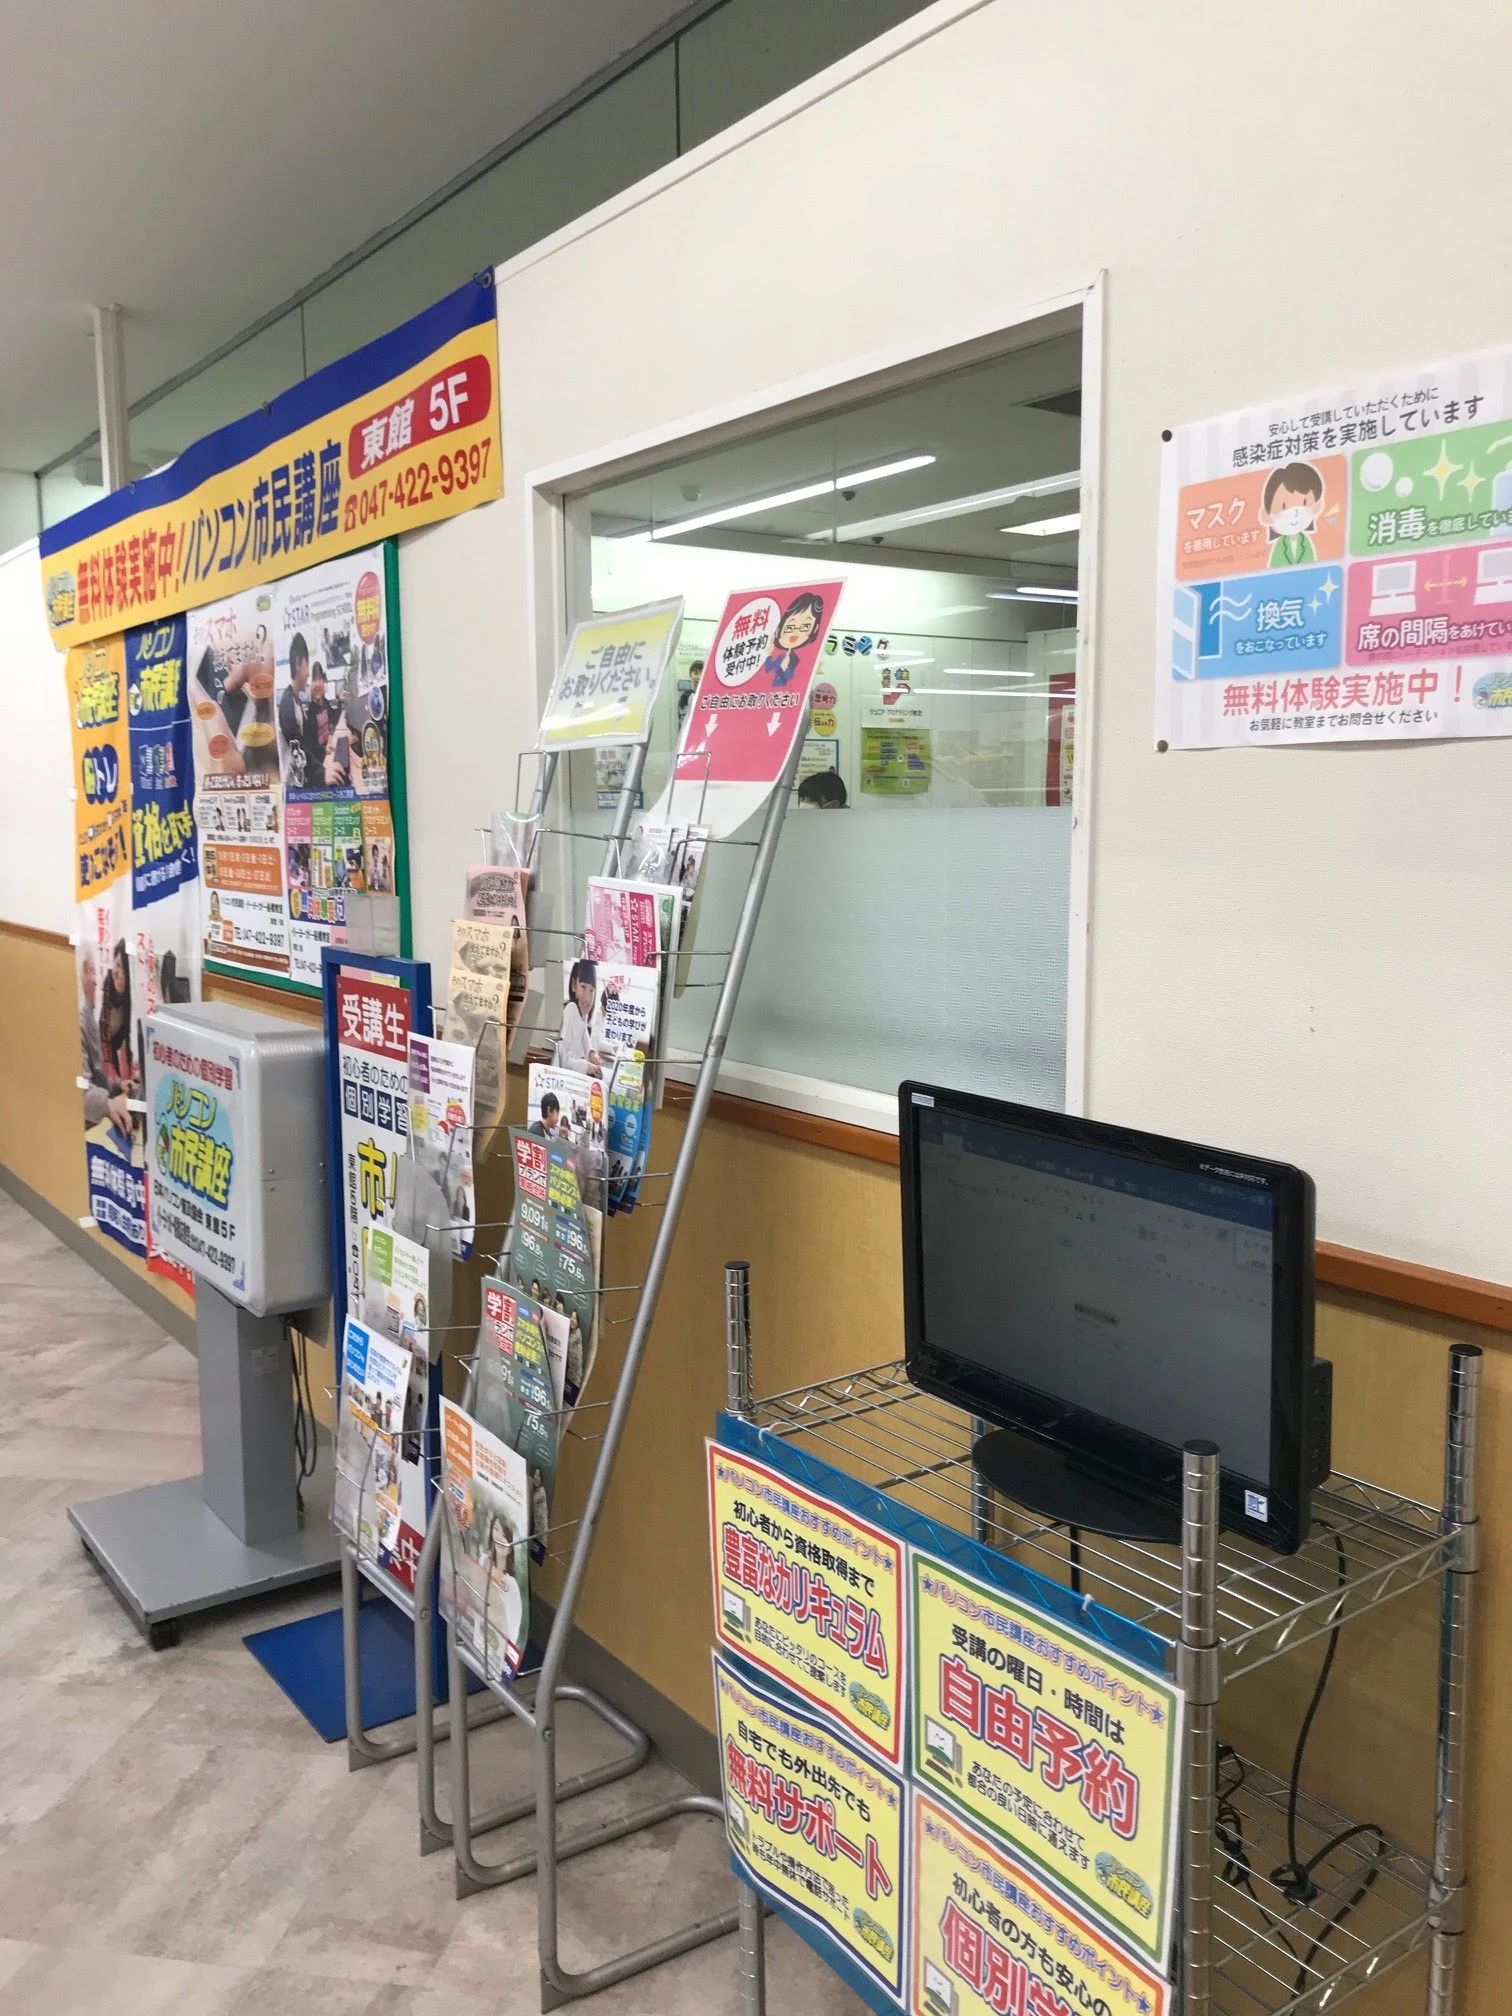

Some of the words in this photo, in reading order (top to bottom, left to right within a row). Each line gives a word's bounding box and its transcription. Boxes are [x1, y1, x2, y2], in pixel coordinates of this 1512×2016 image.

[360, 398, 414, 469] 東館
[428, 372, 469, 431] 5F
[1232, 395, 1485, 468] 感染症対策を実施しています
[1268, 387, 1439, 437] 安心して受講していただくために
[359, 437, 491, 529] 047-422-9397
[1185, 496, 1247, 530] マスク
[731, 605, 771, 641] 無料
[1234, 631, 1328, 656] をおこなっています
[1256, 598, 1305, 632] 換気
[586, 640, 647, 670] ご自由に
[723, 634, 769, 664] 体験予約
[699, 692, 800, 711] ご自由にお取りください
[1249, 709, 1438, 732] お気軽に教室までお問合せください
[341, 993, 407, 1053] 受講生
[733, 1499, 876, 1598] 初心者から資格取得まで
[723, 1522, 889, 1680] 豊富なカリキュラム
[951, 1622, 1126, 1746] 受講の曜日・時間は
[737, 1721, 872, 1823] 自宅でも外出先でも
[939, 1655, 1139, 1841] 自由予約
[725, 1735, 893, 1900] 無料サポート
[971, 1760, 1086, 1849] あなたの予定に合わせて
